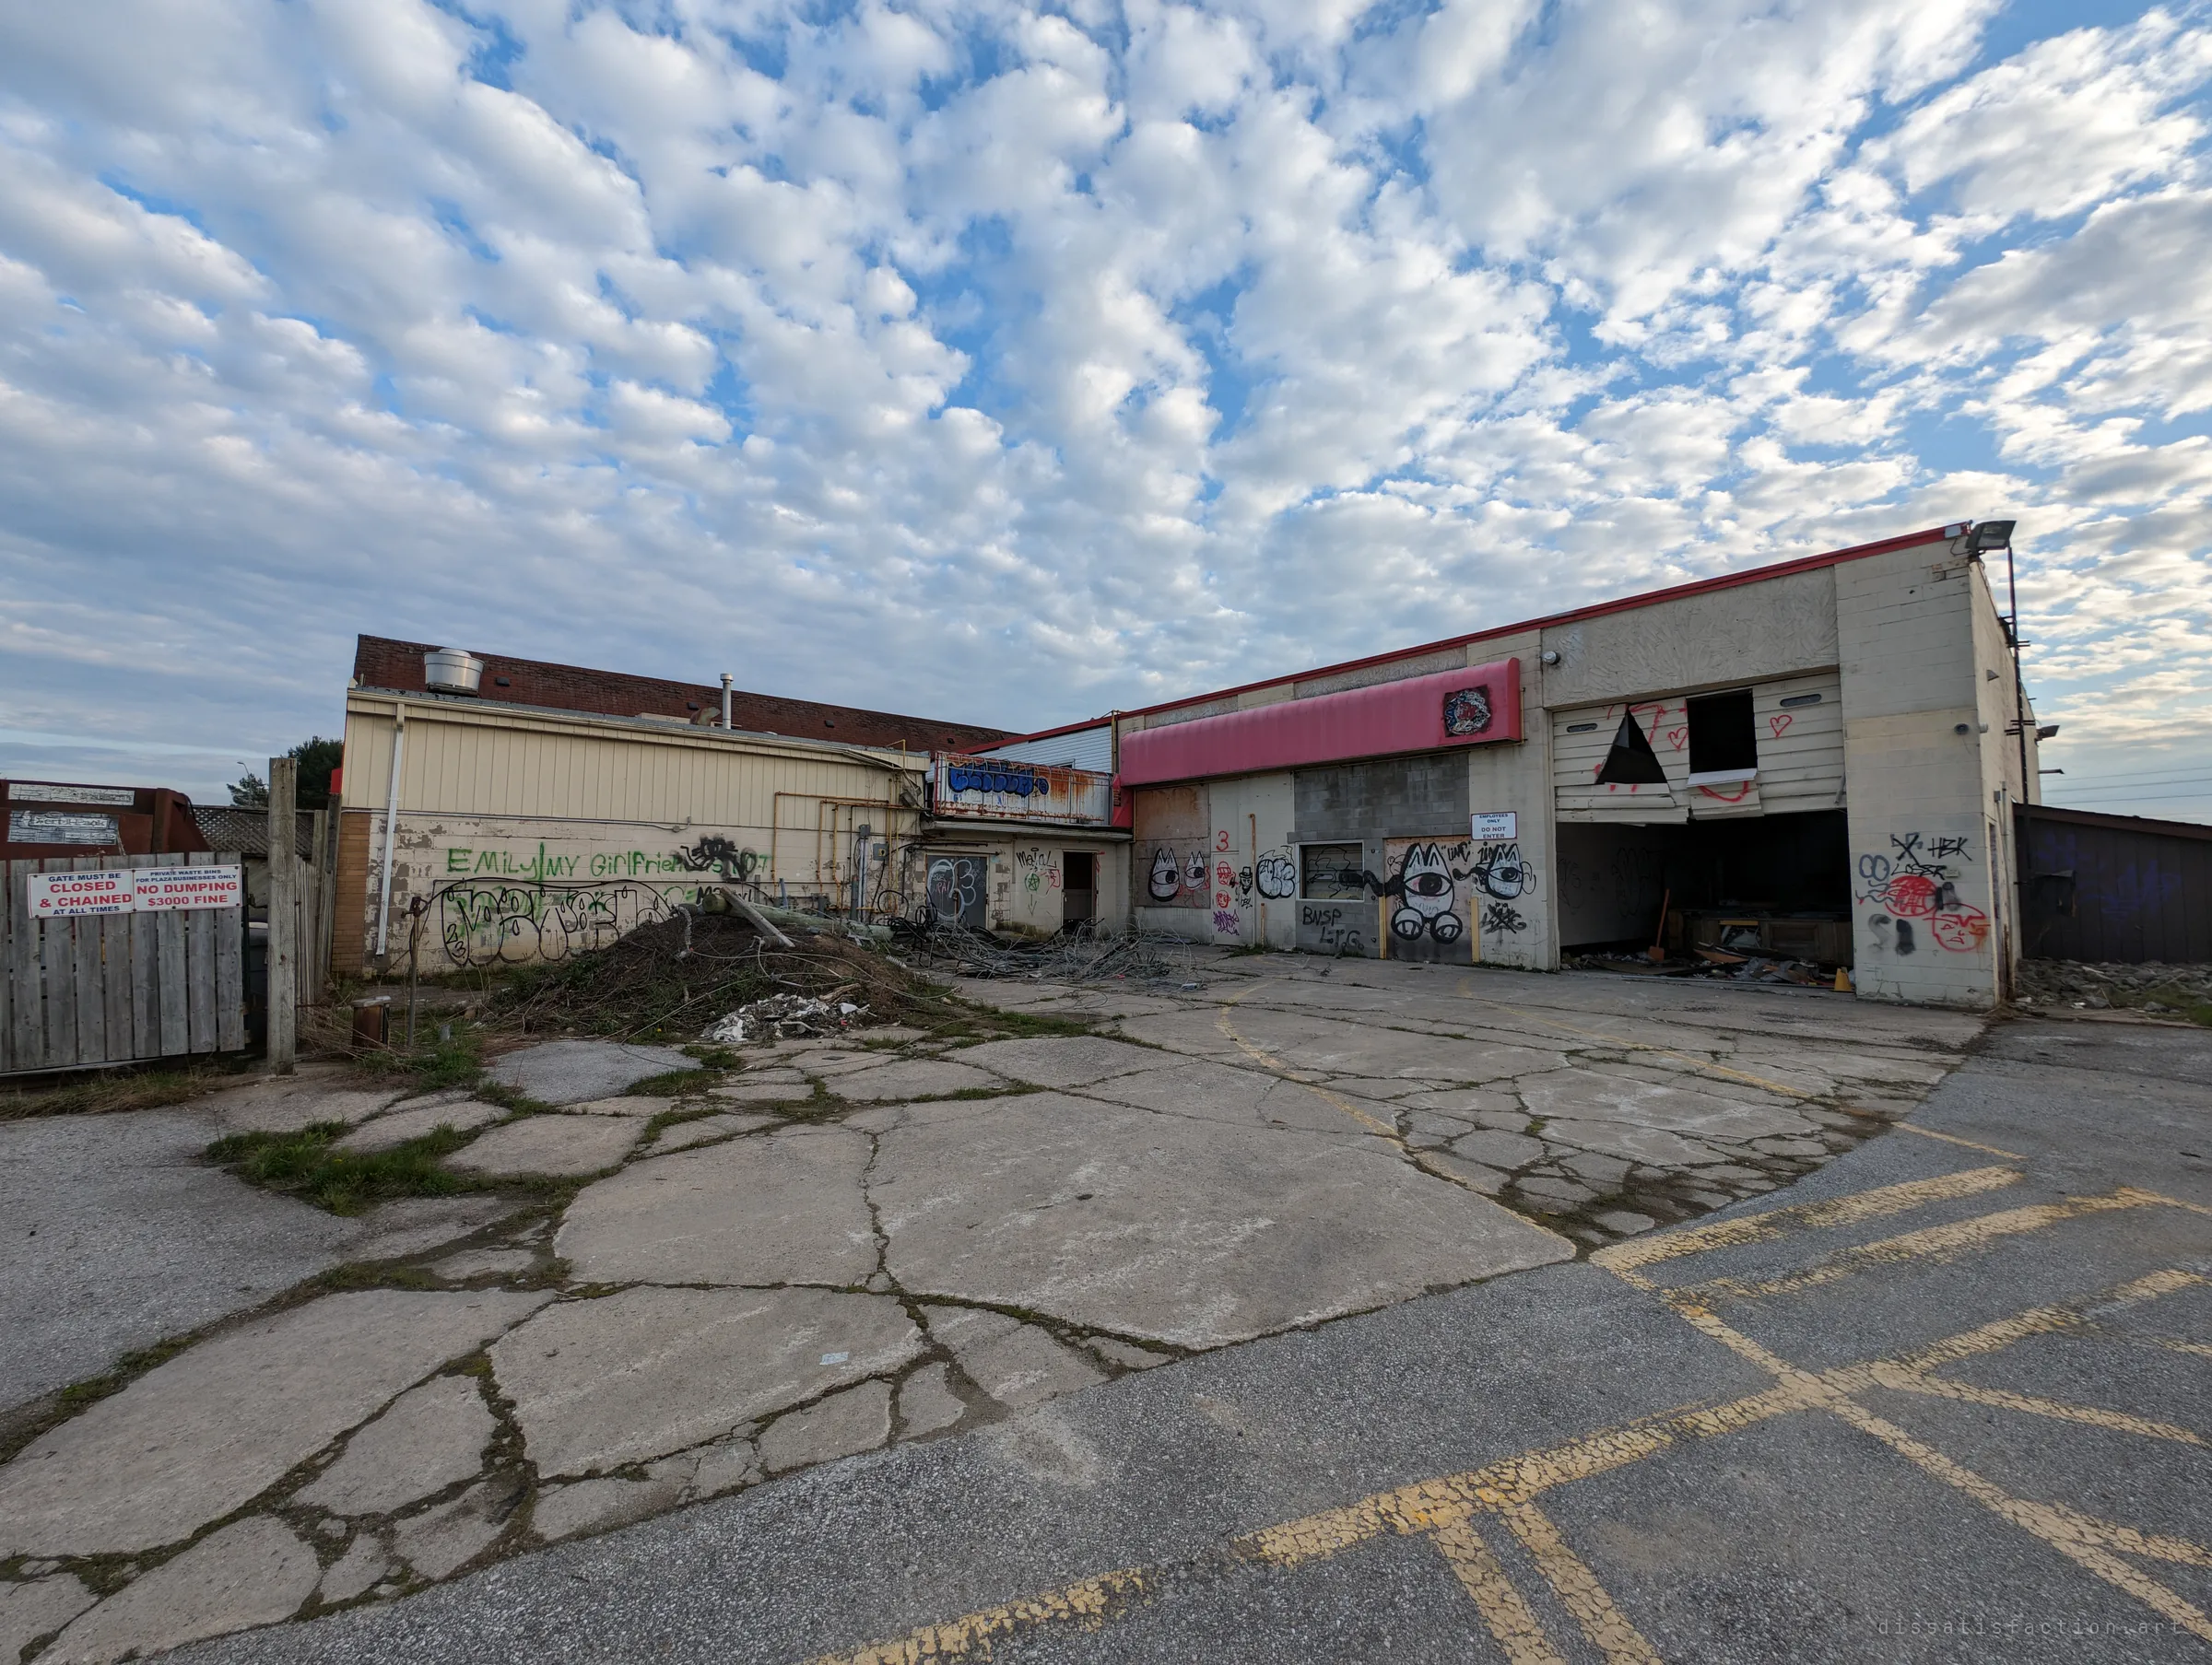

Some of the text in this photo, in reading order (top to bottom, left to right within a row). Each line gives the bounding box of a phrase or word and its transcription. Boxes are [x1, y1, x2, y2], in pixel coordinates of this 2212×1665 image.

[50, 881, 116, 893] CLOSED
[137, 882, 237, 894] NO DUMPING
[40, 894, 133, 908] & CHAINED
[147, 895, 229, 906] $3000 FINE
